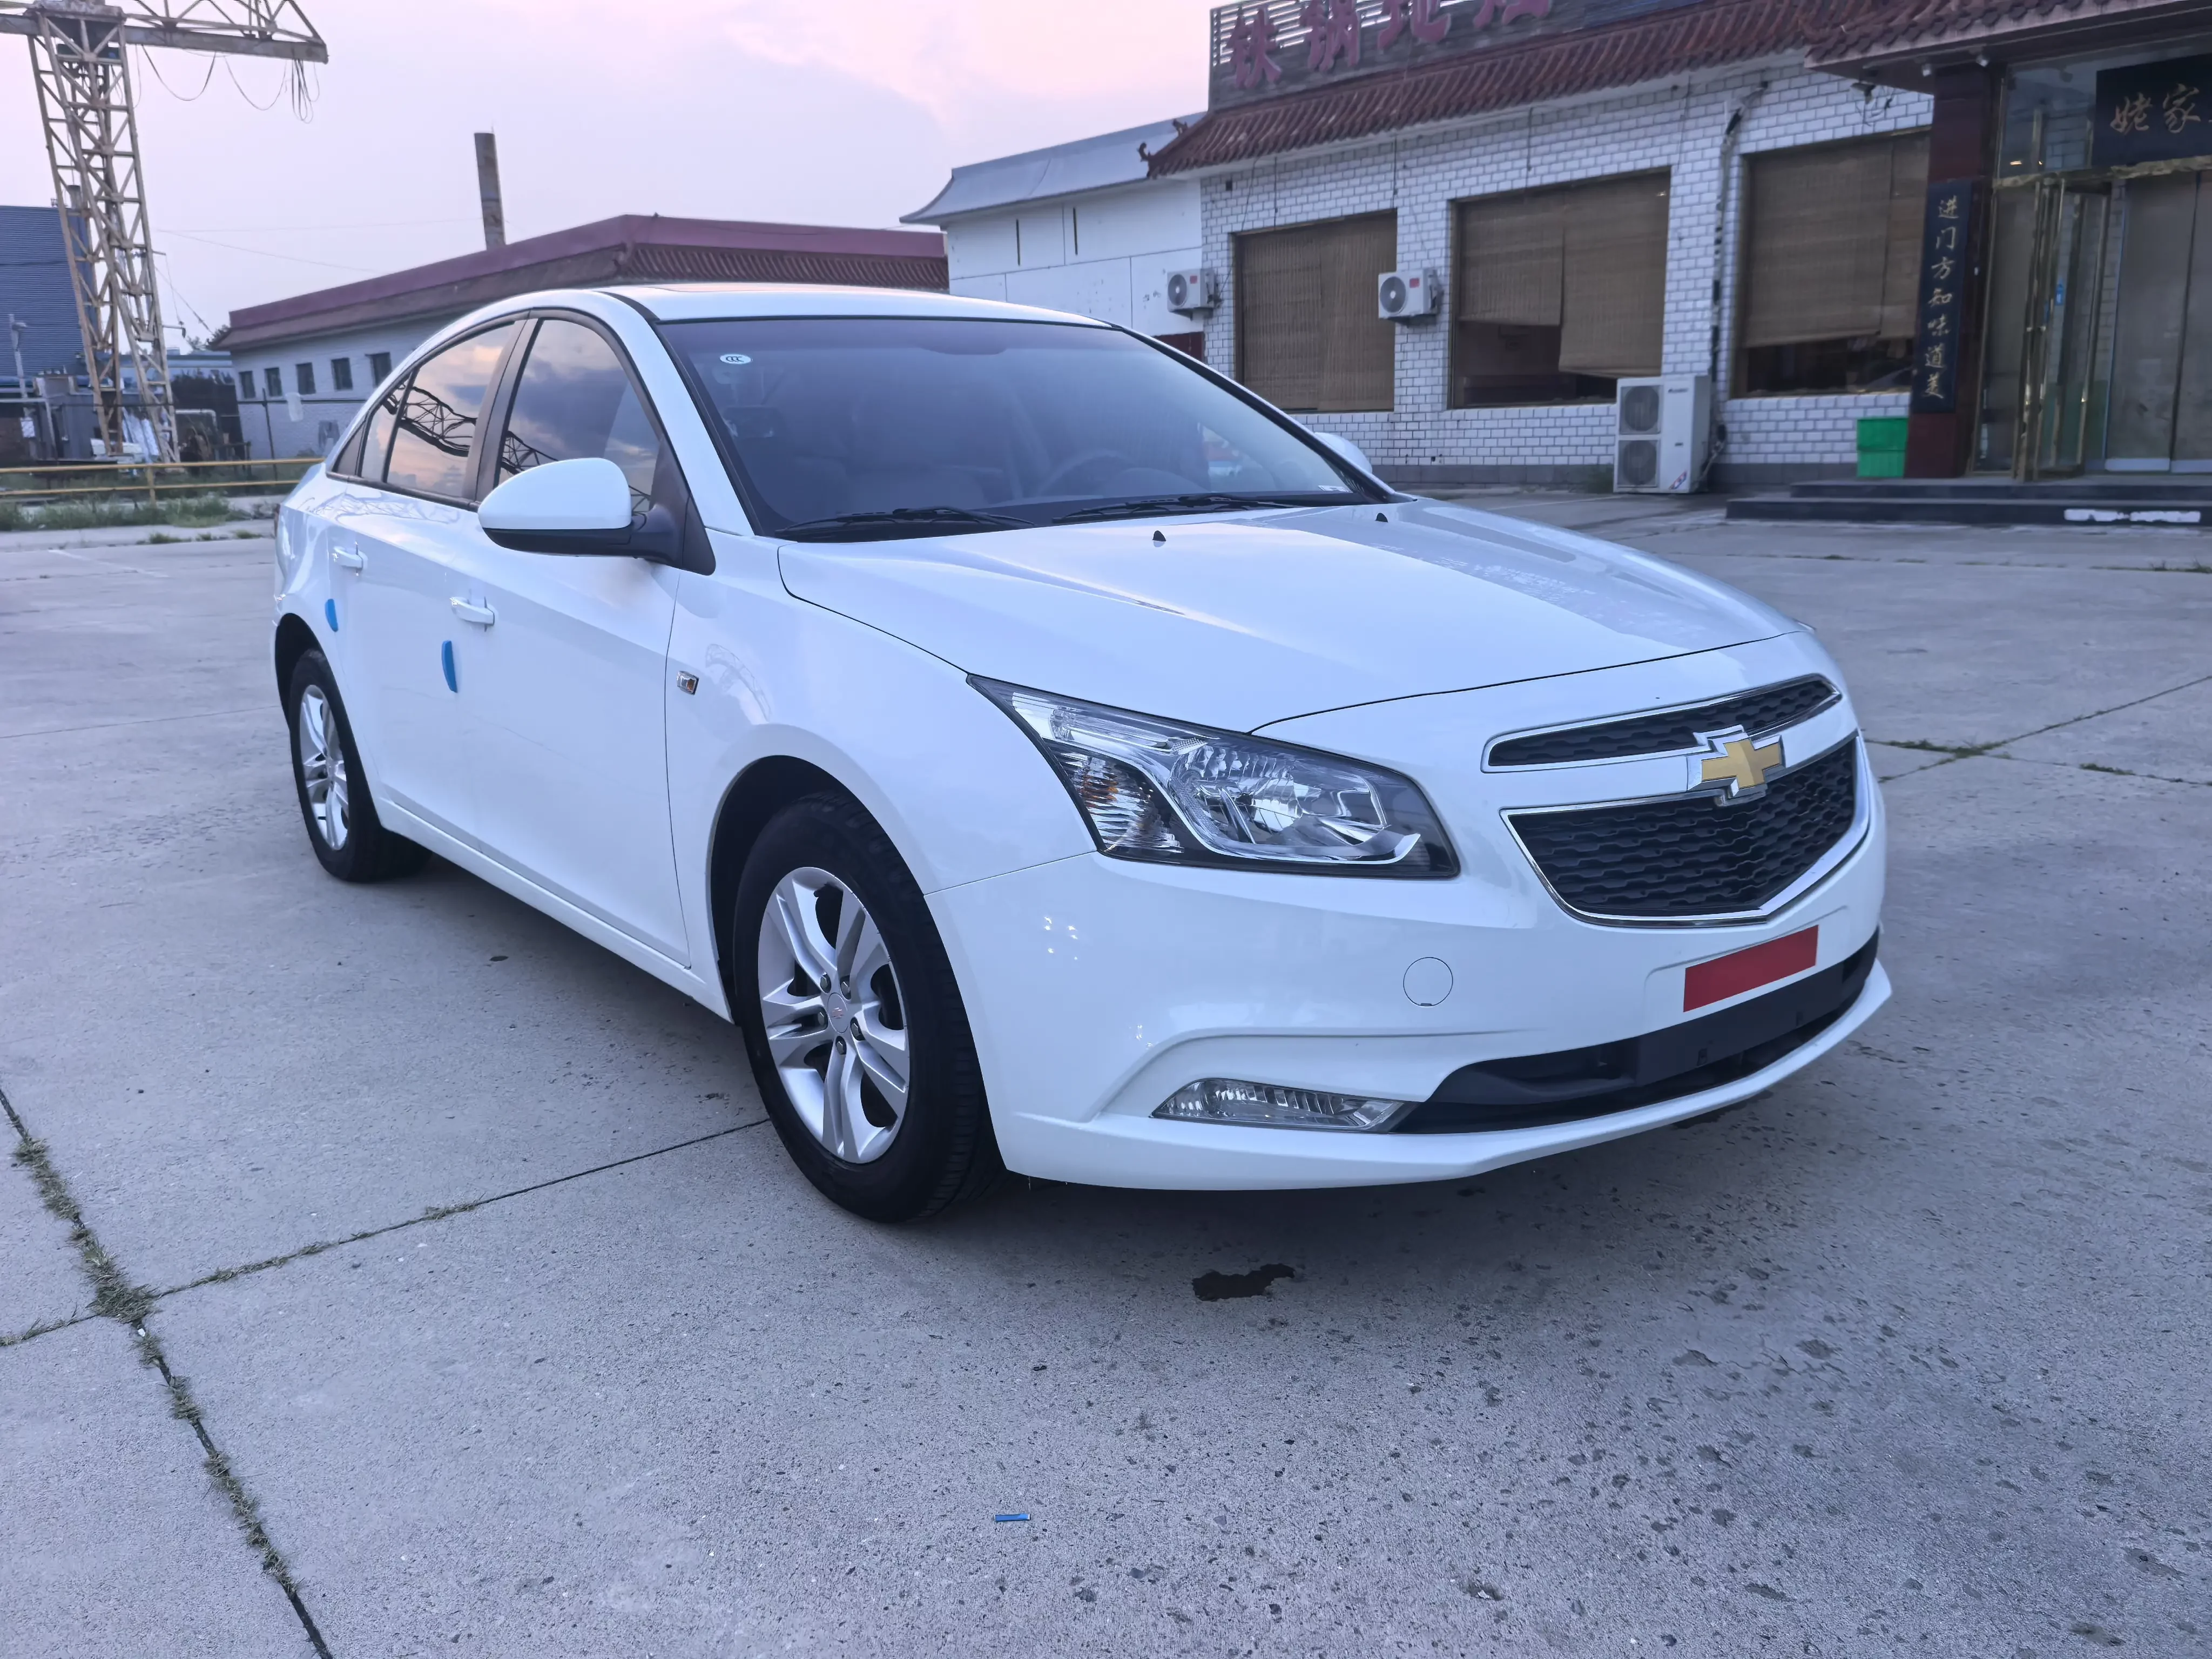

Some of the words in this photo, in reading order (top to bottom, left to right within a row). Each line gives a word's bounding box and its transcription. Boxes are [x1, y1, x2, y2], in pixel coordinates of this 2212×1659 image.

[2109, 83, 2212, 136] 姥家
[1924, 195, 1959, 399] 进门方知味道美
